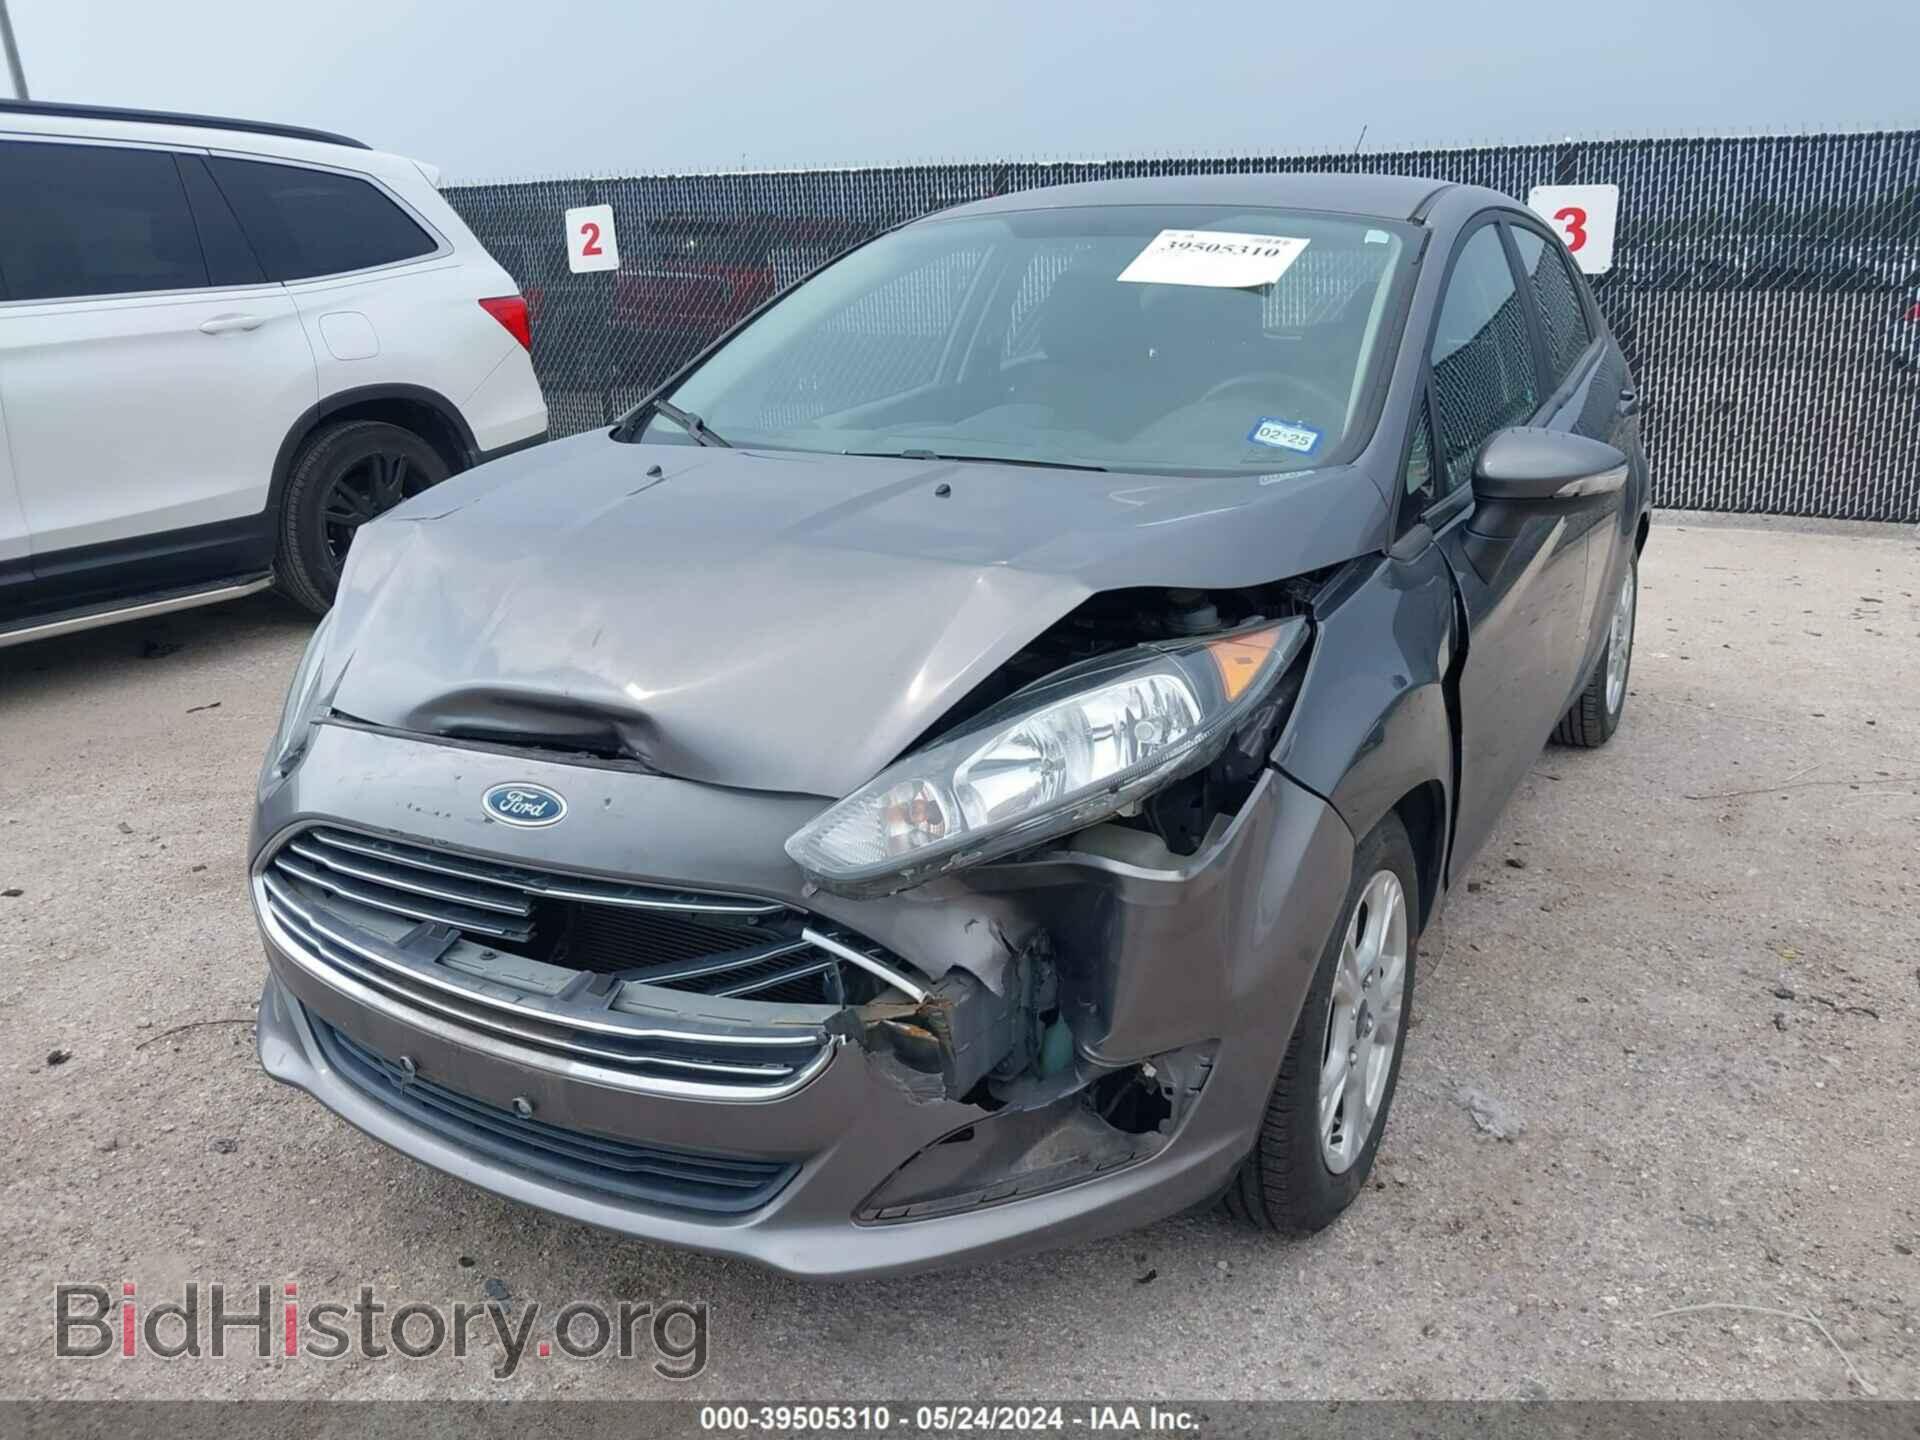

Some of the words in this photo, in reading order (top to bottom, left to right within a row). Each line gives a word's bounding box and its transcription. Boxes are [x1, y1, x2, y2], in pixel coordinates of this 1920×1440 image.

[580, 222, 603, 256] 2
[1553, 207, 1587, 252] 3
[1167, 240, 1280, 258] 39505310
[499, 790, 548, 817] Ford
